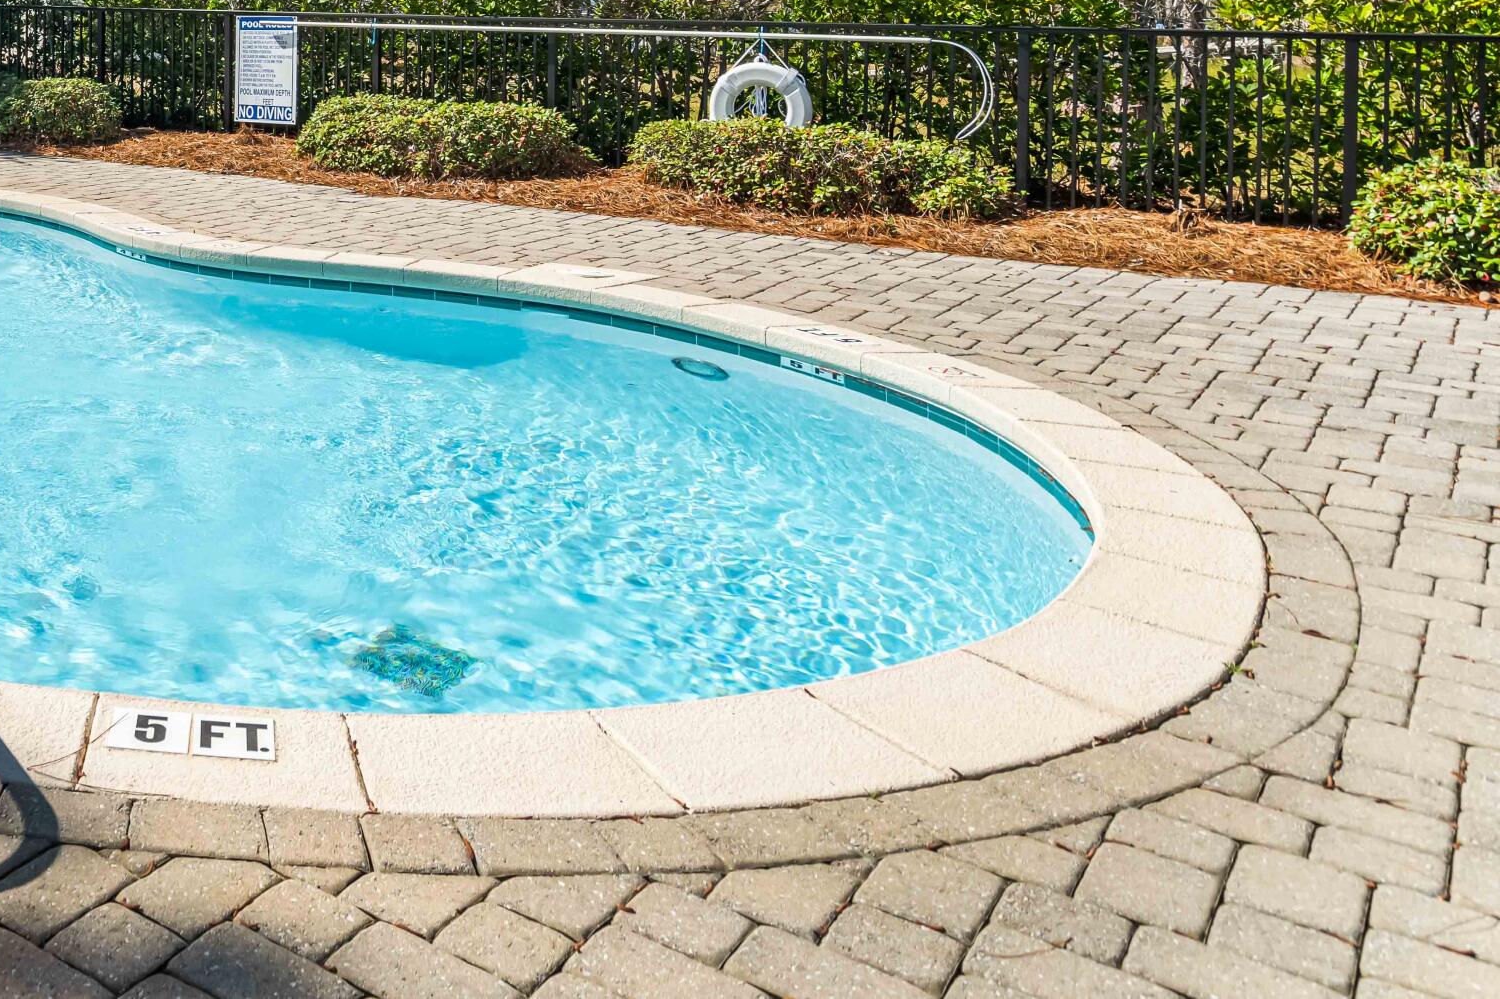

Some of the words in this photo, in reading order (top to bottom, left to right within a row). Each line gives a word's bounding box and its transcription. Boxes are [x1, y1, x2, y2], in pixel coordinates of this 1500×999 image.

[241, 21, 263, 29] POOL
[239, 106, 254, 119] NO
[257, 107, 292, 121] DIVING
[790, 359, 803, 369] 5
[134, 714, 169, 743] 5
[200, 719, 270, 752] FT.
